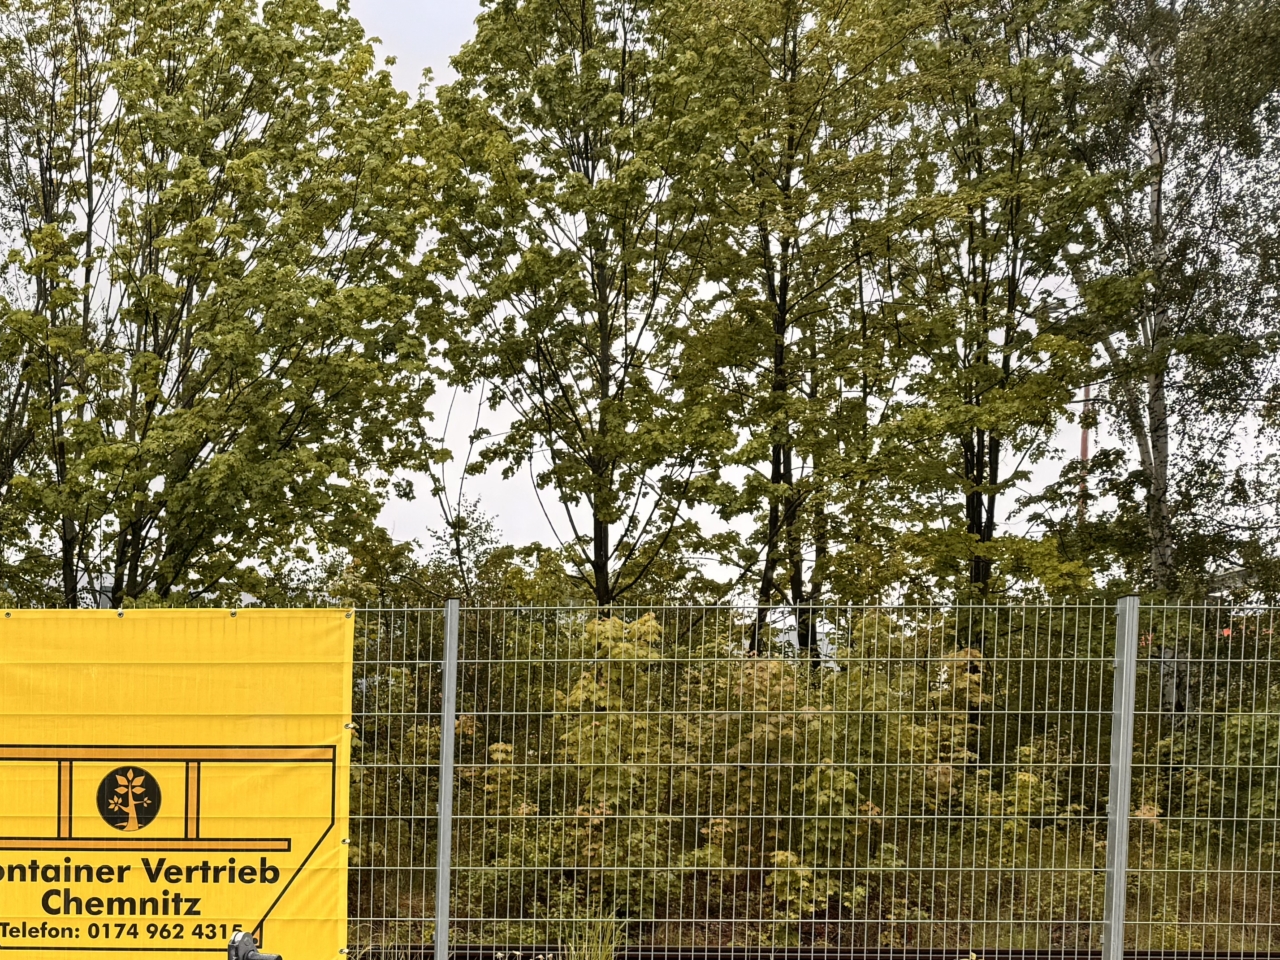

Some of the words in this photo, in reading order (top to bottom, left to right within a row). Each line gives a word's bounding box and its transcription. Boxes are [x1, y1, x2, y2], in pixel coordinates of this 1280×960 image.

[141, 857, 280, 884] Vertrieb
[41, 888, 202, 916] Chemnitz
[0, 921, 80, 940] Telefon:
[87, 923, 139, 940] 0174
[146, 923, 185, 940] 962
